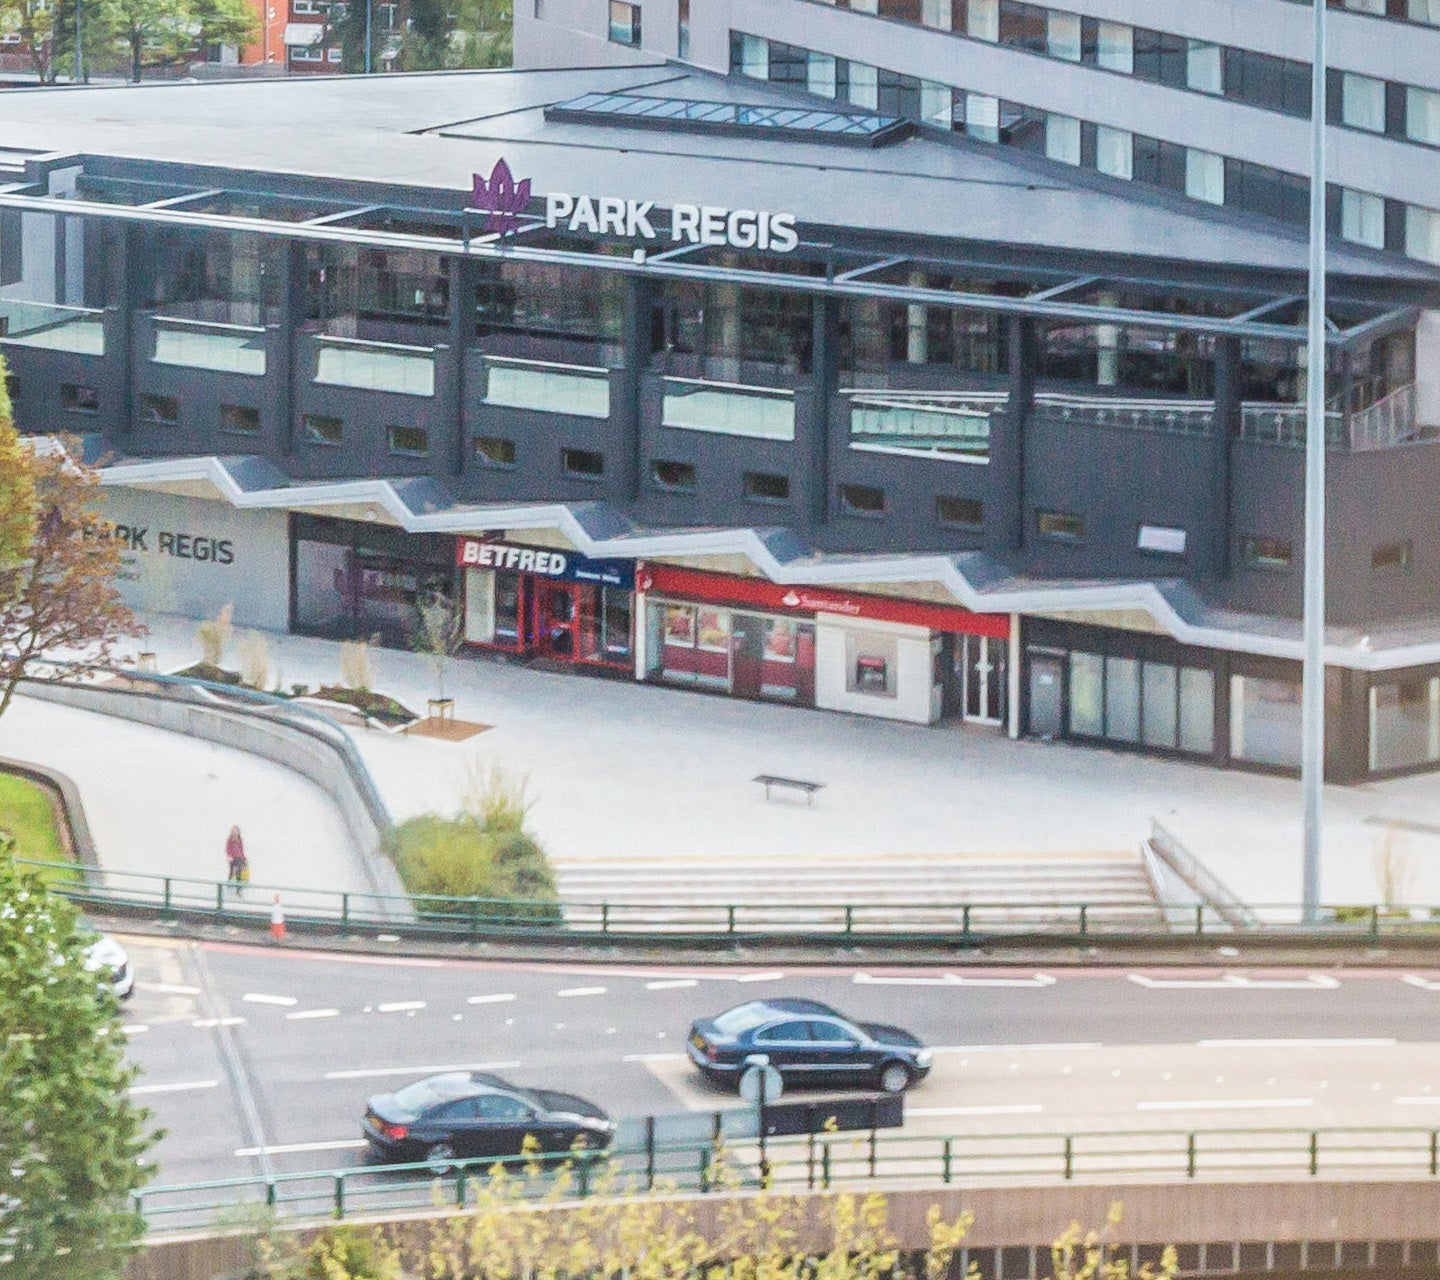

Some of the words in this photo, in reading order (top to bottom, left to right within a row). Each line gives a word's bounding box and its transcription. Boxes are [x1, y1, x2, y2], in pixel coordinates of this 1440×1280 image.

[546, 192, 656, 239] PARK
[672, 203, 799, 253] REGIS
[158, 530, 235, 565] REGIS
[463, 541, 567, 576] BETFRED
